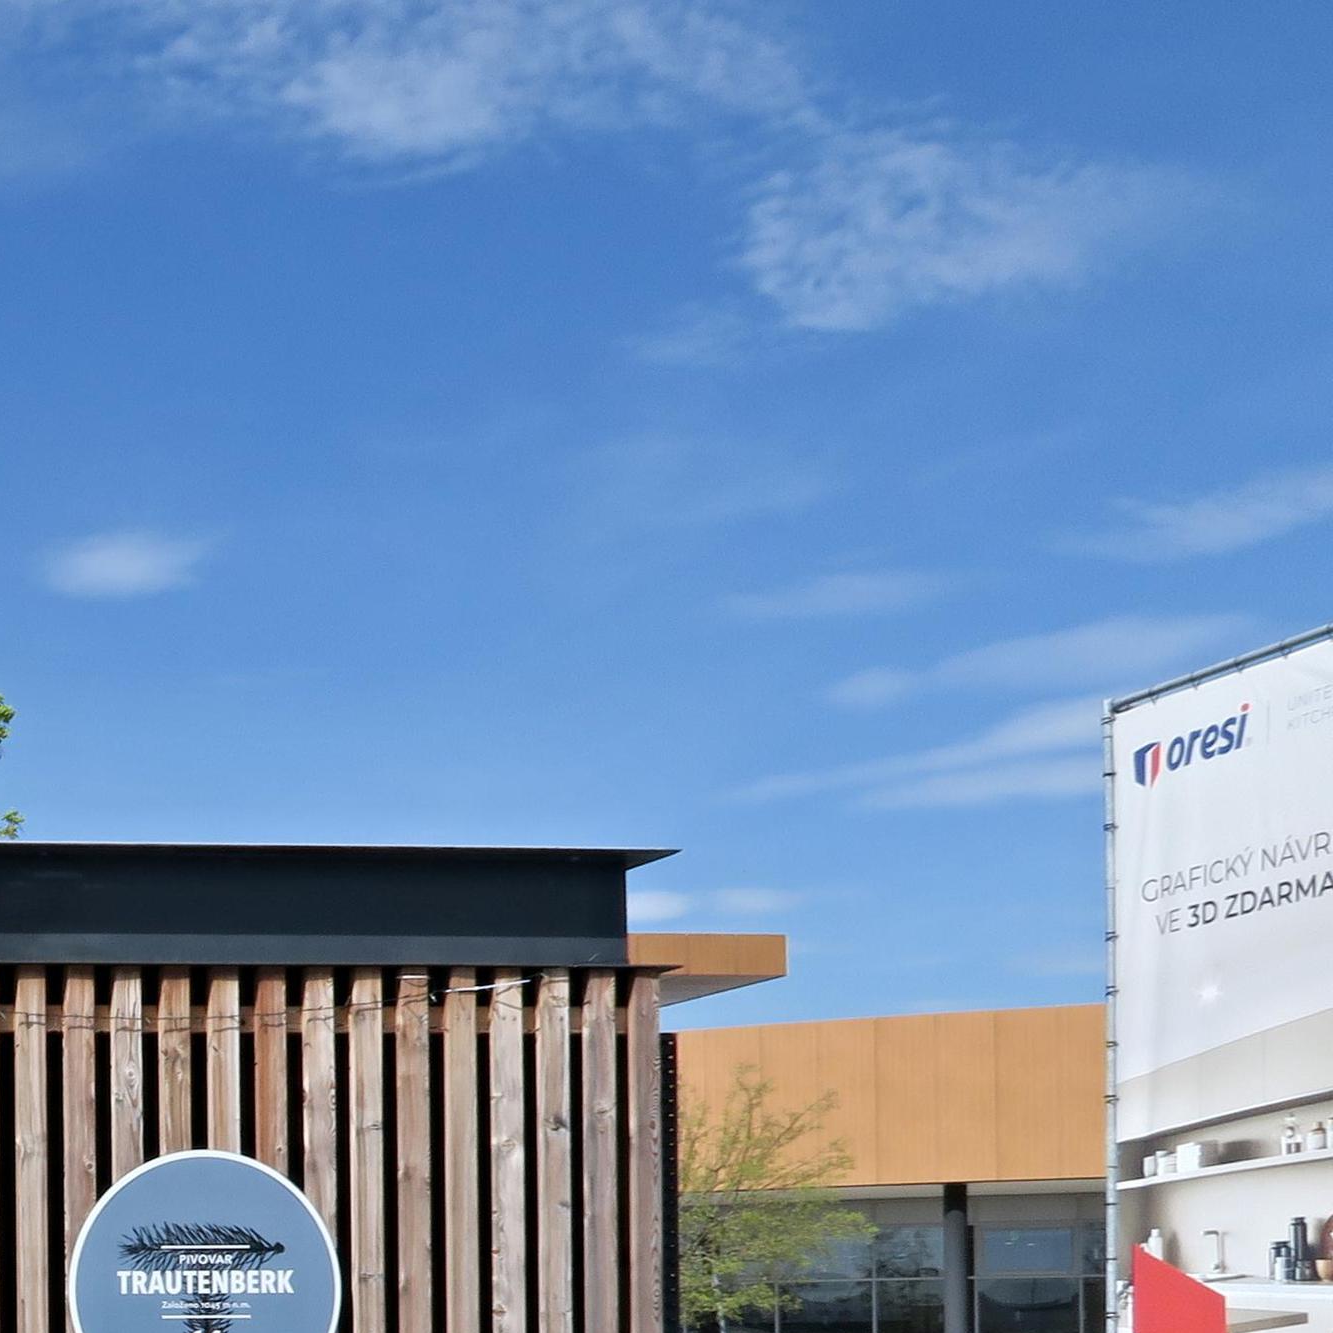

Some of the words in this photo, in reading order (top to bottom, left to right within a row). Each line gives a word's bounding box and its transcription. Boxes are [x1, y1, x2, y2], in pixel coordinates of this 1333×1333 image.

[1166, 703, 1250, 772] oresi
[1141, 846, 1253, 903] GRAFICKÝ
[1155, 908, 1182, 935] VE
[1186, 900, 1219, 928] 3D
[1224, 871, 1333, 920] ZDARMA
[116, 1269, 295, 1295] TRAUTENBERK
[179, 1254, 233, 1265] PIVOVAR
